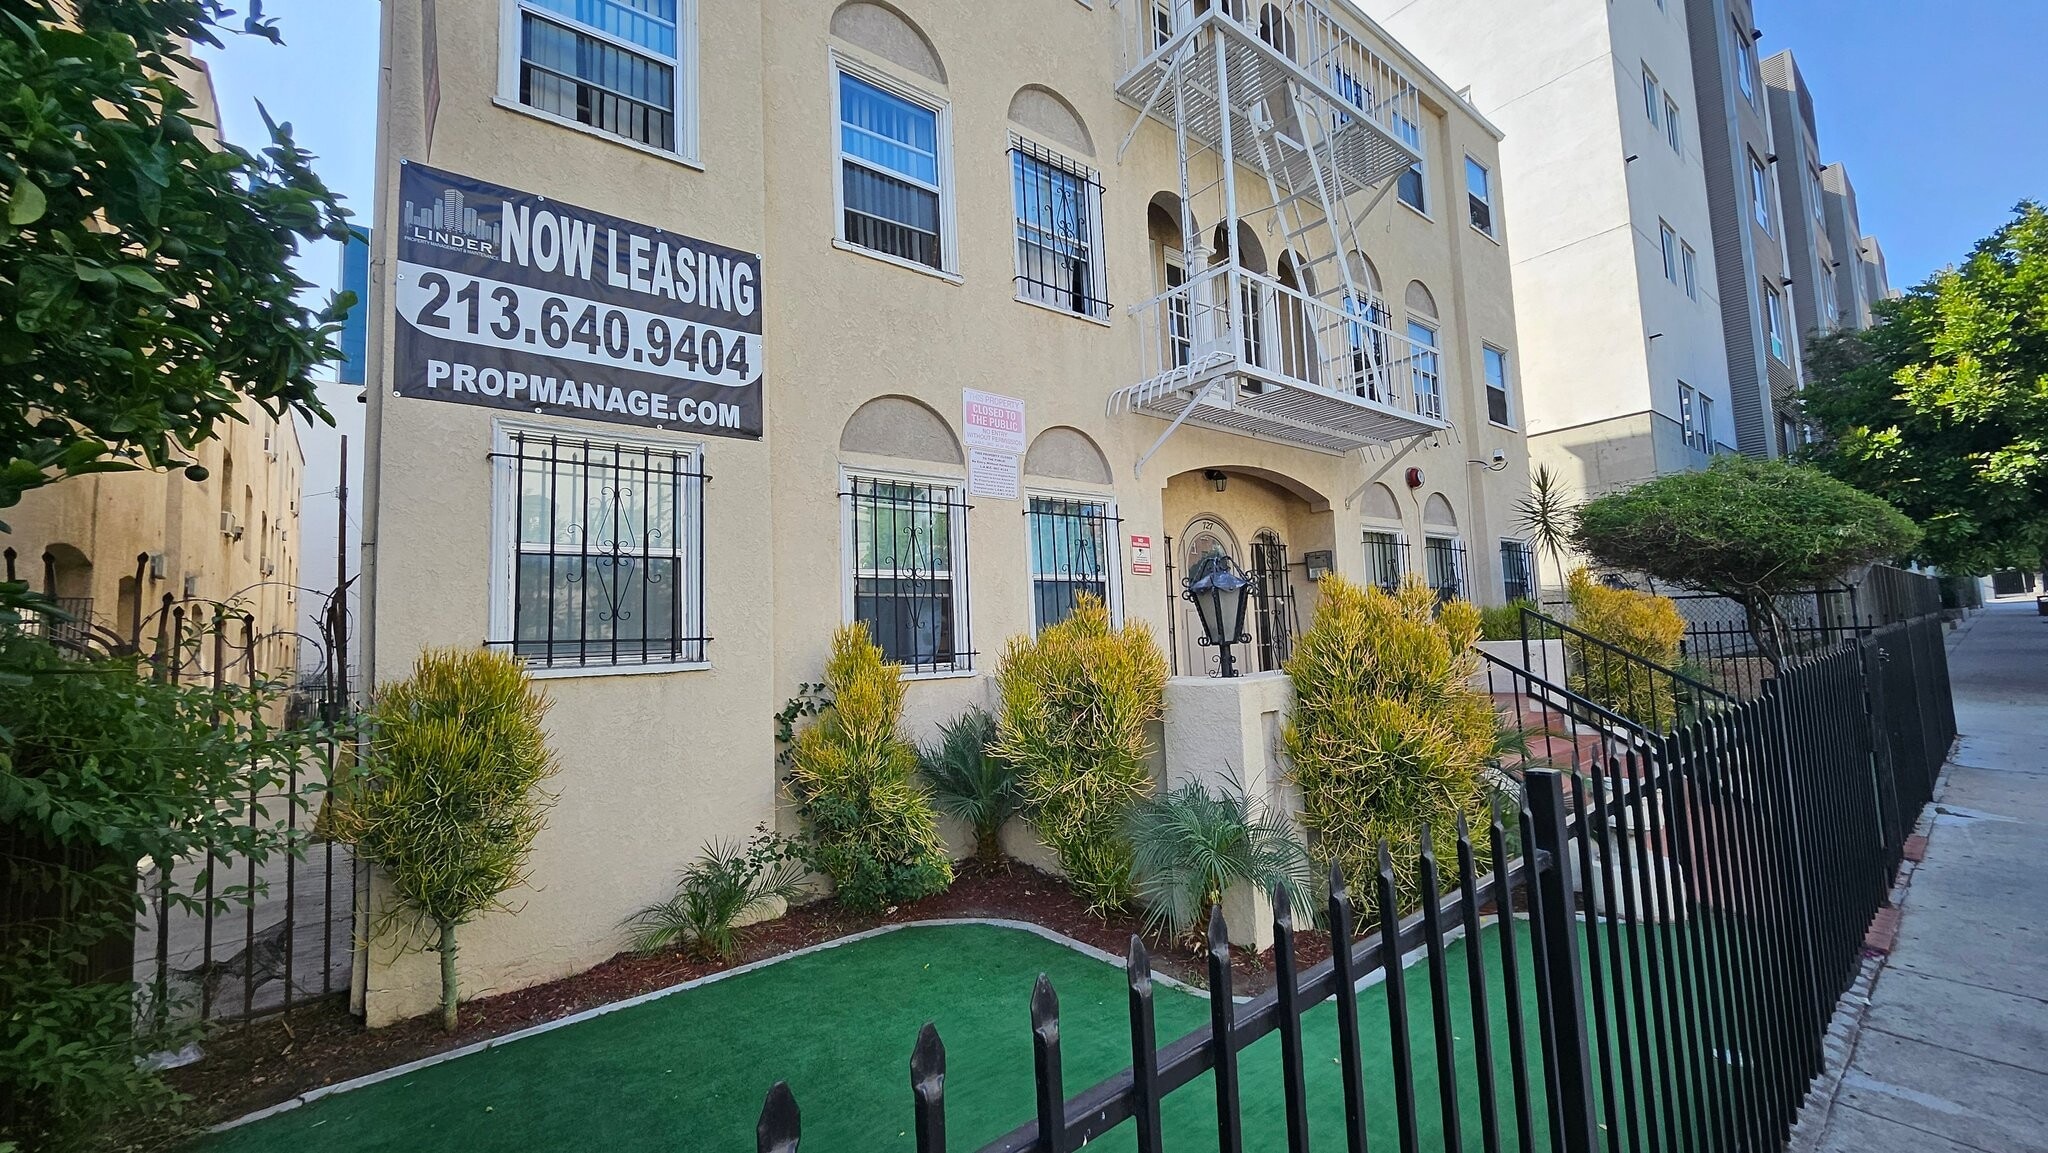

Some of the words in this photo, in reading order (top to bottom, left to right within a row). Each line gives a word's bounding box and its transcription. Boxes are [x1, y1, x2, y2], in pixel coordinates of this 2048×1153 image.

[404, 235, 431, 246] PROPERTY
[431, 241, 463, 253] MANAGEMENT
[467, 249, 500, 261] MAINTENANCE
[414, 226, 493, 254] LINDER
[501, 200, 596, 281] NOW
[607, 229, 755, 316] LEASING
[416, 272, 750, 381] 213.640.9404
[427, 359, 740, 429] PROPMANAGE.COM
[985, 395, 1020, 409] PROPERTY
[972, 403, 1004, 418] CLOSED
[1005, 410, 1017, 421] TO
[971, 413, 988, 426] THE
[989, 417, 1018, 432] PUBLIC
[966, 431, 991, 441] WITHOUT
[991, 435, 1023, 446] PERMISSION
[991, 429, 1009, 438] ENTRY
[1202, 521, 1214, 531] 727
